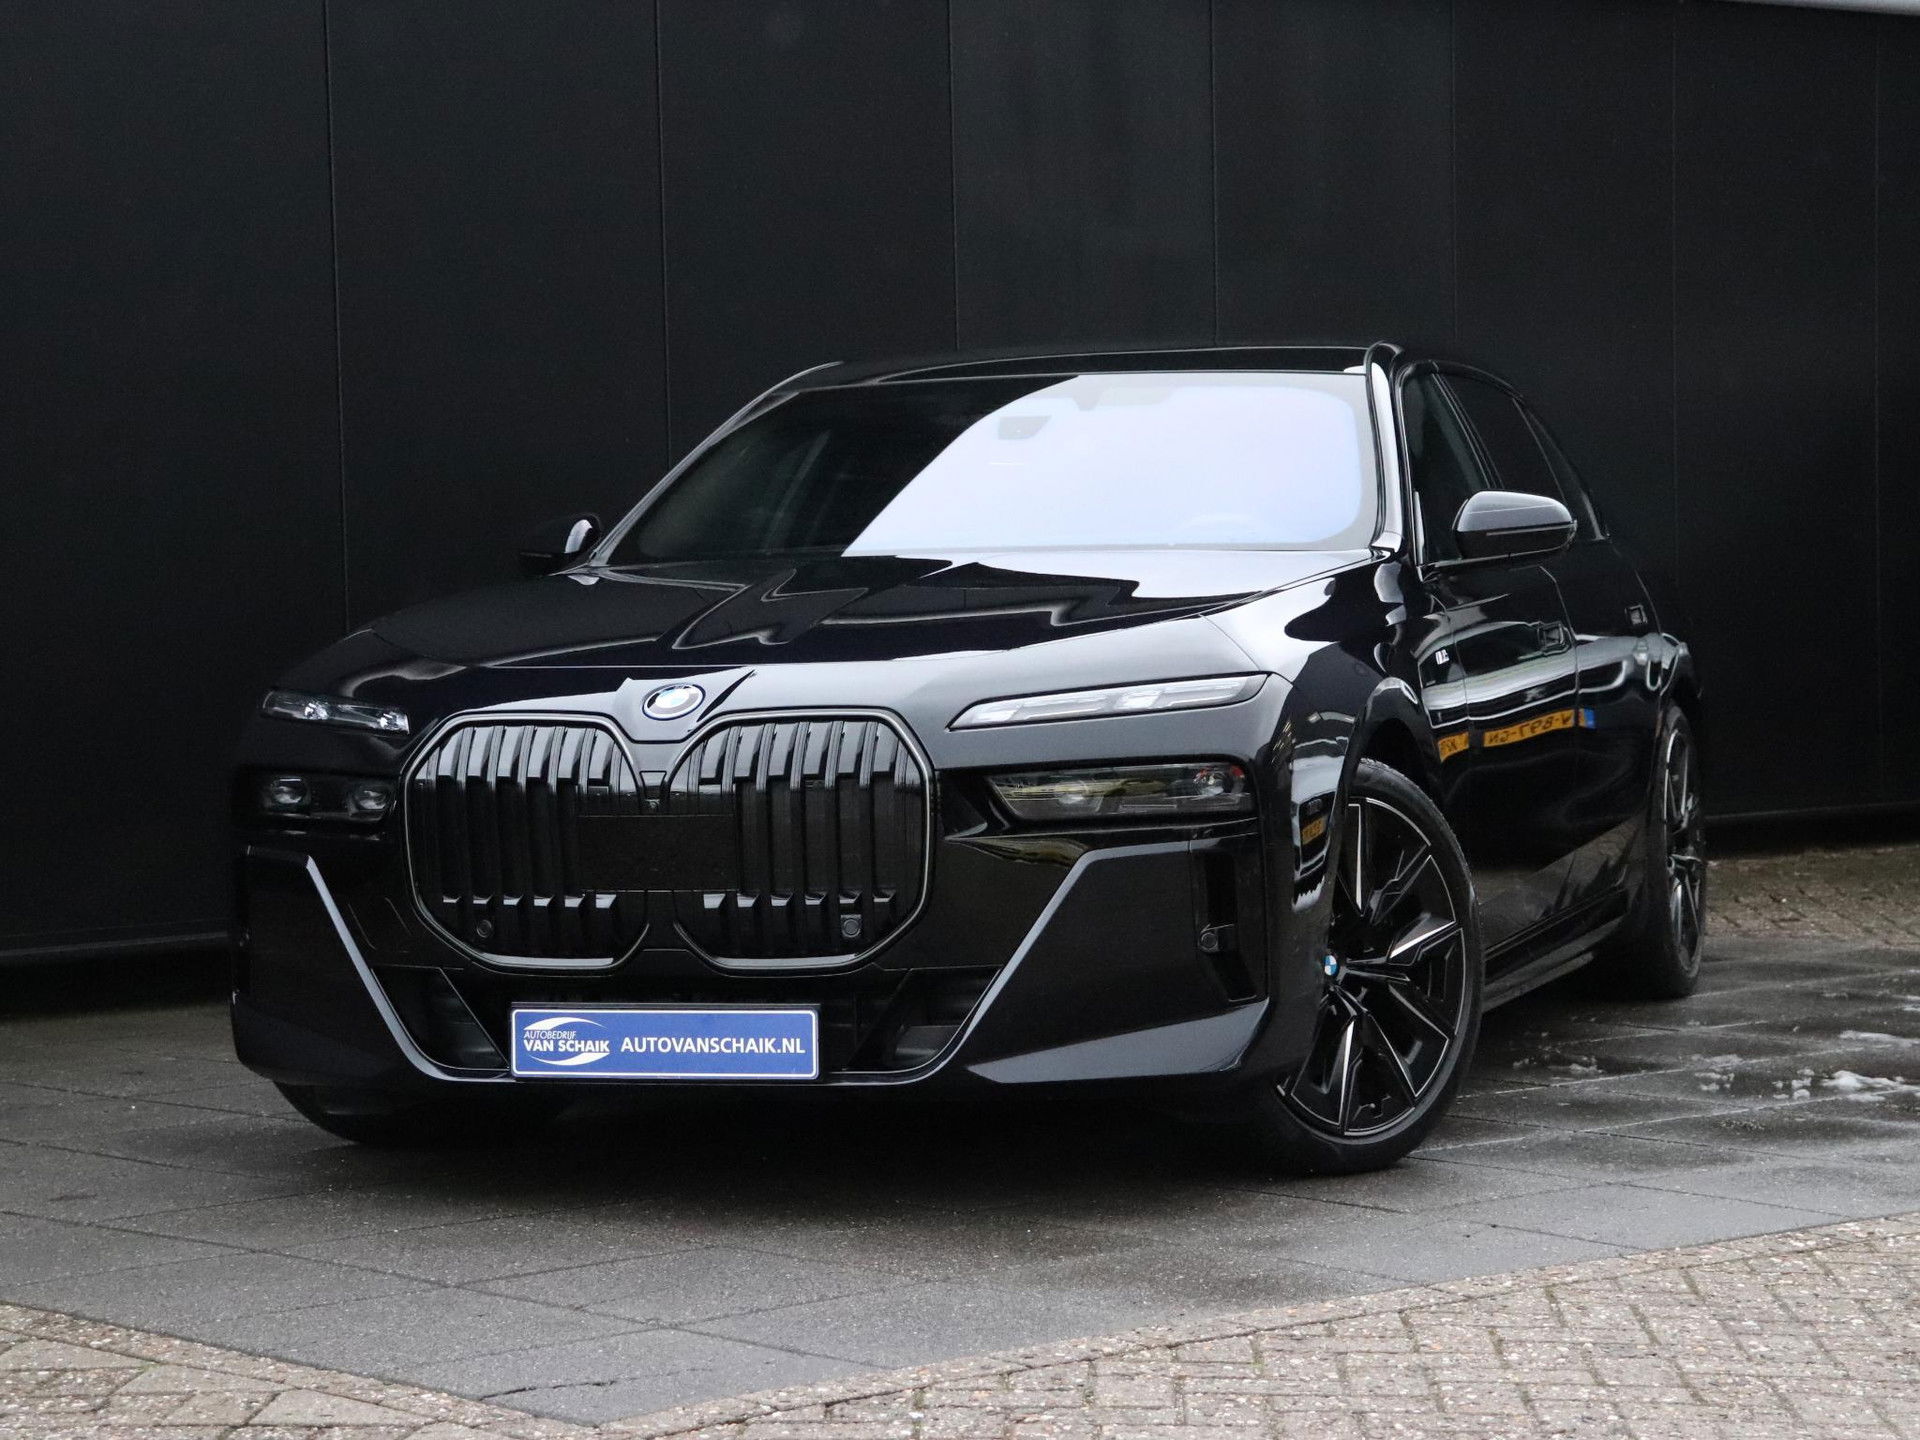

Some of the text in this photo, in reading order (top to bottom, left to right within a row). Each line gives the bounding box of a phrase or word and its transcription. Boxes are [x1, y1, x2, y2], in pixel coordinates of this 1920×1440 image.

[523, 1030, 577, 1040] AUTOBEDRIJF
[523, 1040, 610, 1052] VAN SCHAIK
[620, 1037, 806, 1054] AUTOVANSCHAIK.NL
